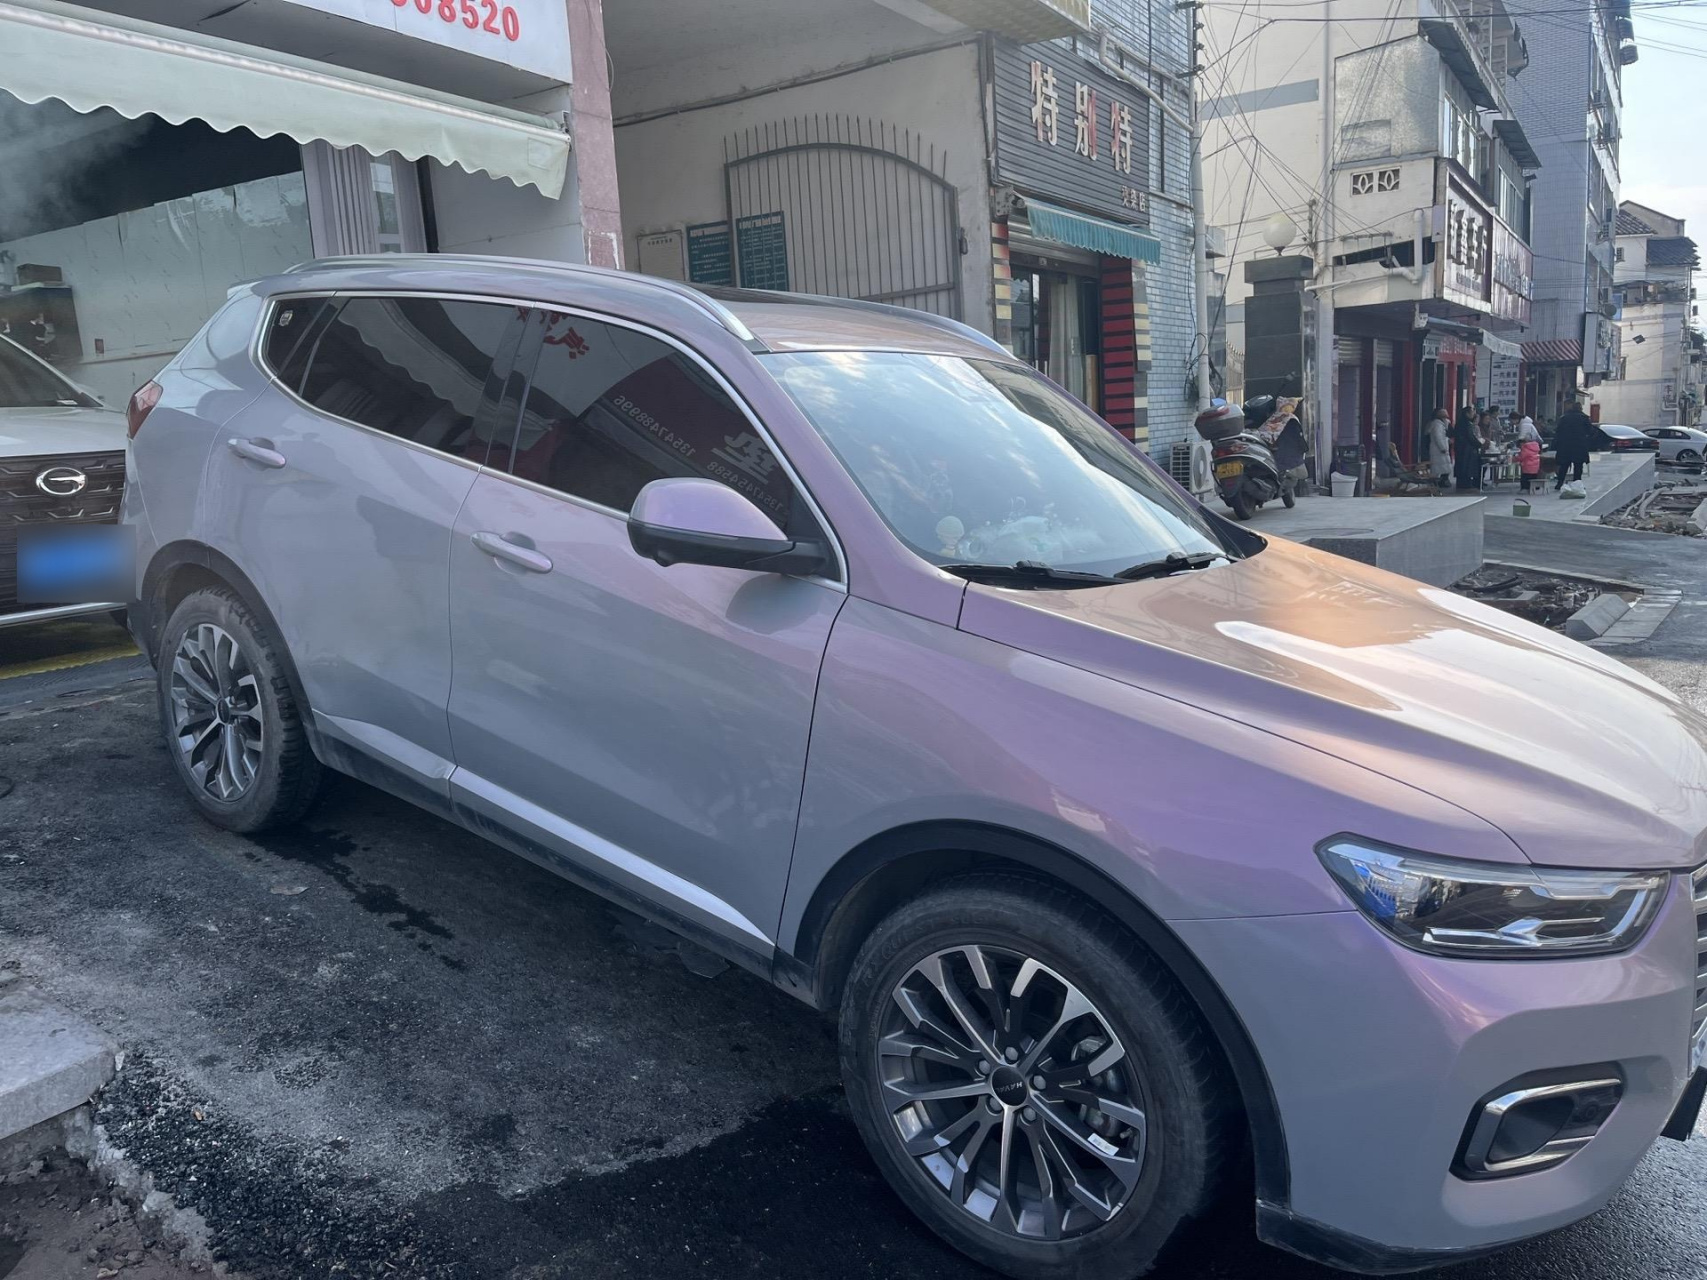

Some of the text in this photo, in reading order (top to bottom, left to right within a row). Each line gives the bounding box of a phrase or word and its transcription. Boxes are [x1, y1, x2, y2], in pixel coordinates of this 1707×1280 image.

[391, 0, 520, 42] 8520
[1030, 60, 1133, 175] 特别特
